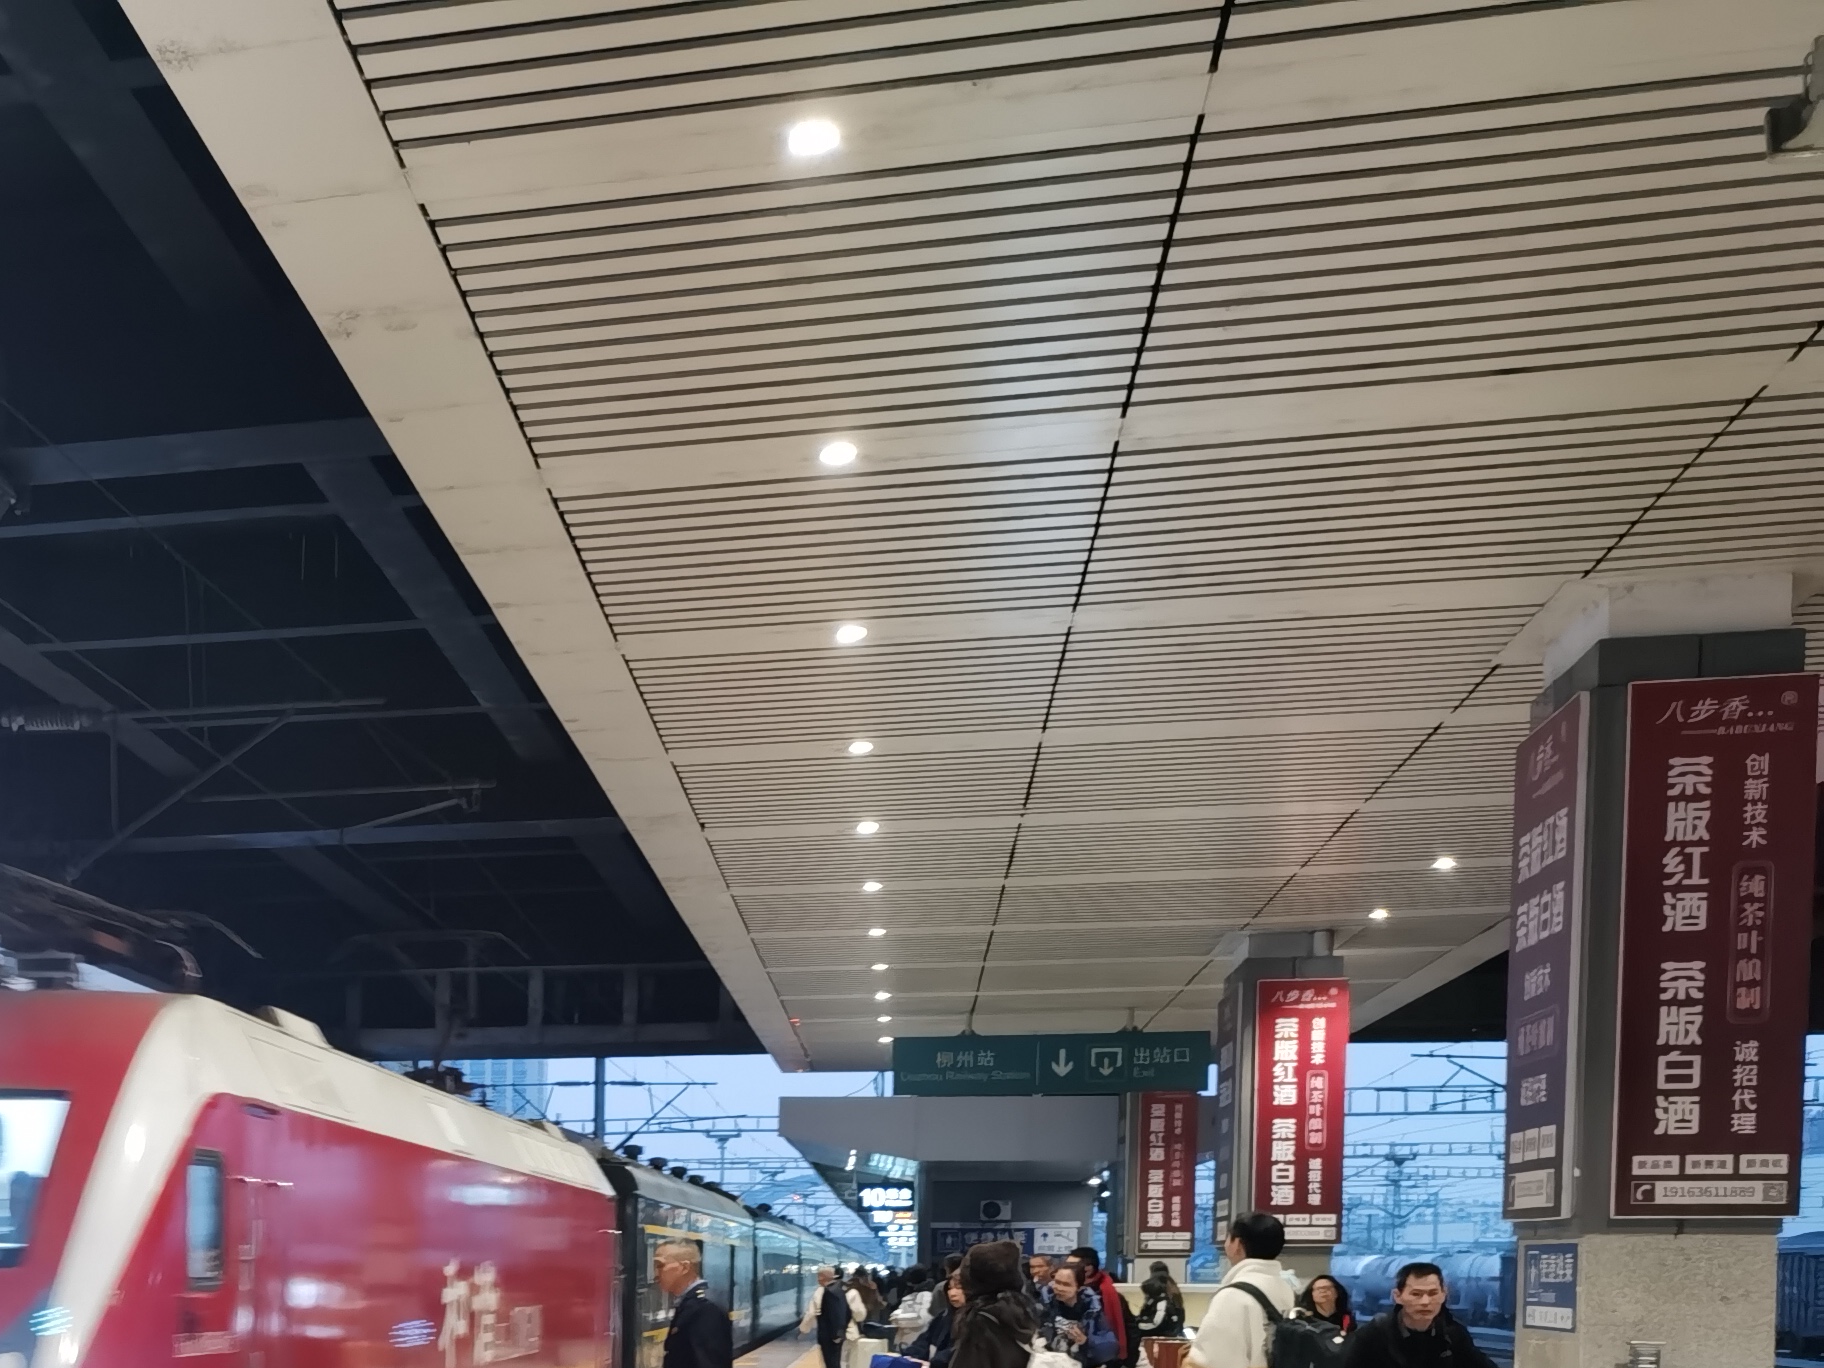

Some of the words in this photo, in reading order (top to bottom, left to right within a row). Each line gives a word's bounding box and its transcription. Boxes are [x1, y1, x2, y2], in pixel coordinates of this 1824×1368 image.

[1661, 756, 1714, 932] 茶版红酒
[1742, 752, 1770, 848] 创新技术
[936, 1050, 996, 1068] 柳州站
[1133, 1046, 1190, 1064] 出站口
[1272, 1017, 1300, 1106] 茶版红酒
[1654, 961, 1707, 1135] 茶版白酒
[1730, 1040, 1760, 1134] 诚招代理
[1270, 1118, 1297, 1206] 茶版白酒
